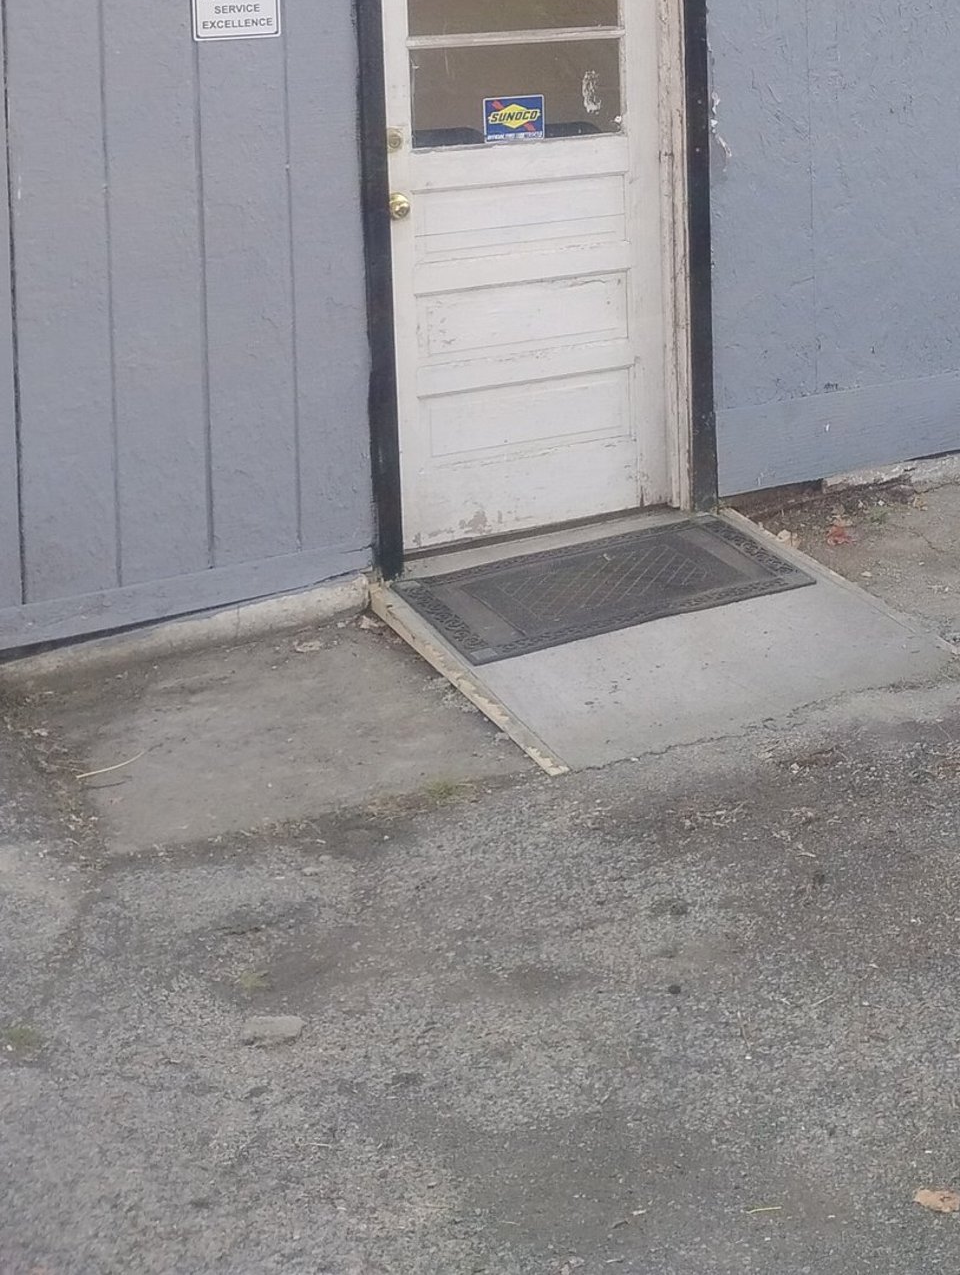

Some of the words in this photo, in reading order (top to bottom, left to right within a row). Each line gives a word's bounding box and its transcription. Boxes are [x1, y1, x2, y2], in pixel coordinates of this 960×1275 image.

[214, 3, 260, 15] SERVICE
[202, 17, 273, 30] EXCELLENCE
[490, 110, 538, 123] SUNOCO
